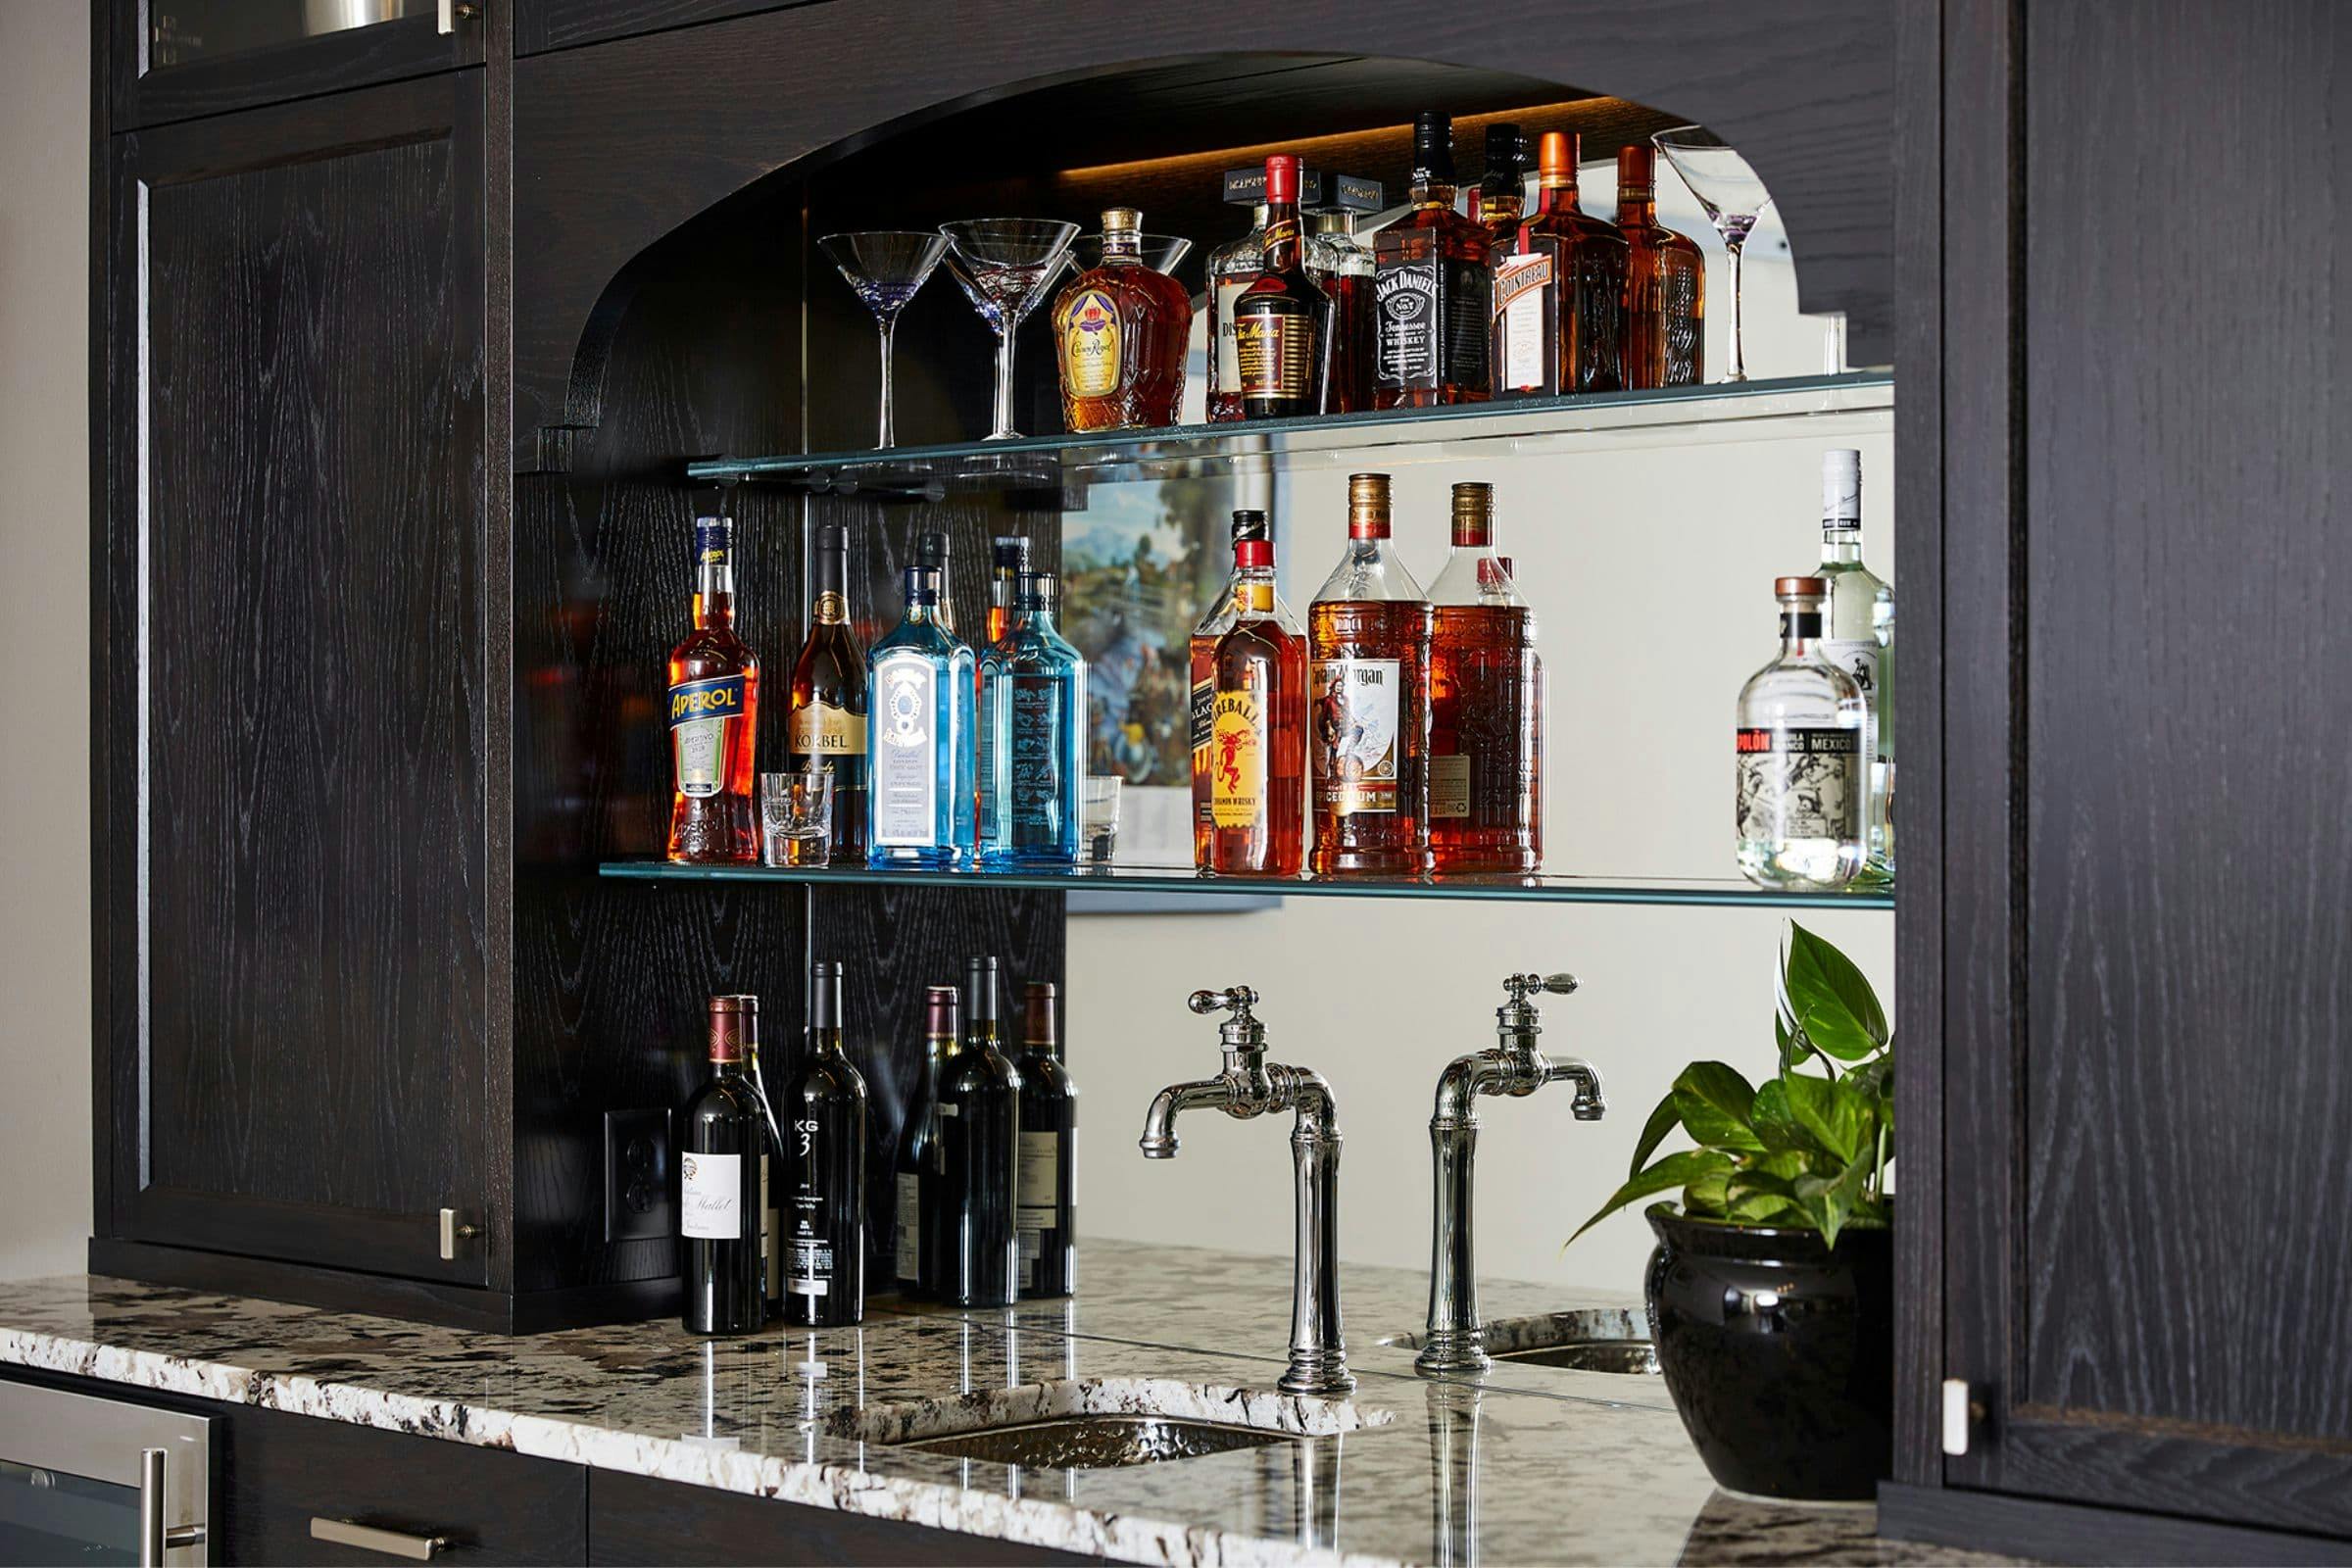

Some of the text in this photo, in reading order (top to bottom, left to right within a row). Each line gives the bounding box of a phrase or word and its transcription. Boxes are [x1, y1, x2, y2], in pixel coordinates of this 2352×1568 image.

[1376, 275, 1398, 302] JACK
[1497, 262, 1548, 307] COINTREAU
[1247, 320, 1280, 339] Maria
[1386, 335, 1426, 346] WHISKEY
[1338, 664, 1383, 686] Mrgan
[671, 688, 737, 720] APEROL
[795, 734, 847, 748] KORBEL
[1811, 738, 1851, 751] MEXICO
[795, 1119, 818, 1132] KG
[800, 1133, 810, 1156] 3
